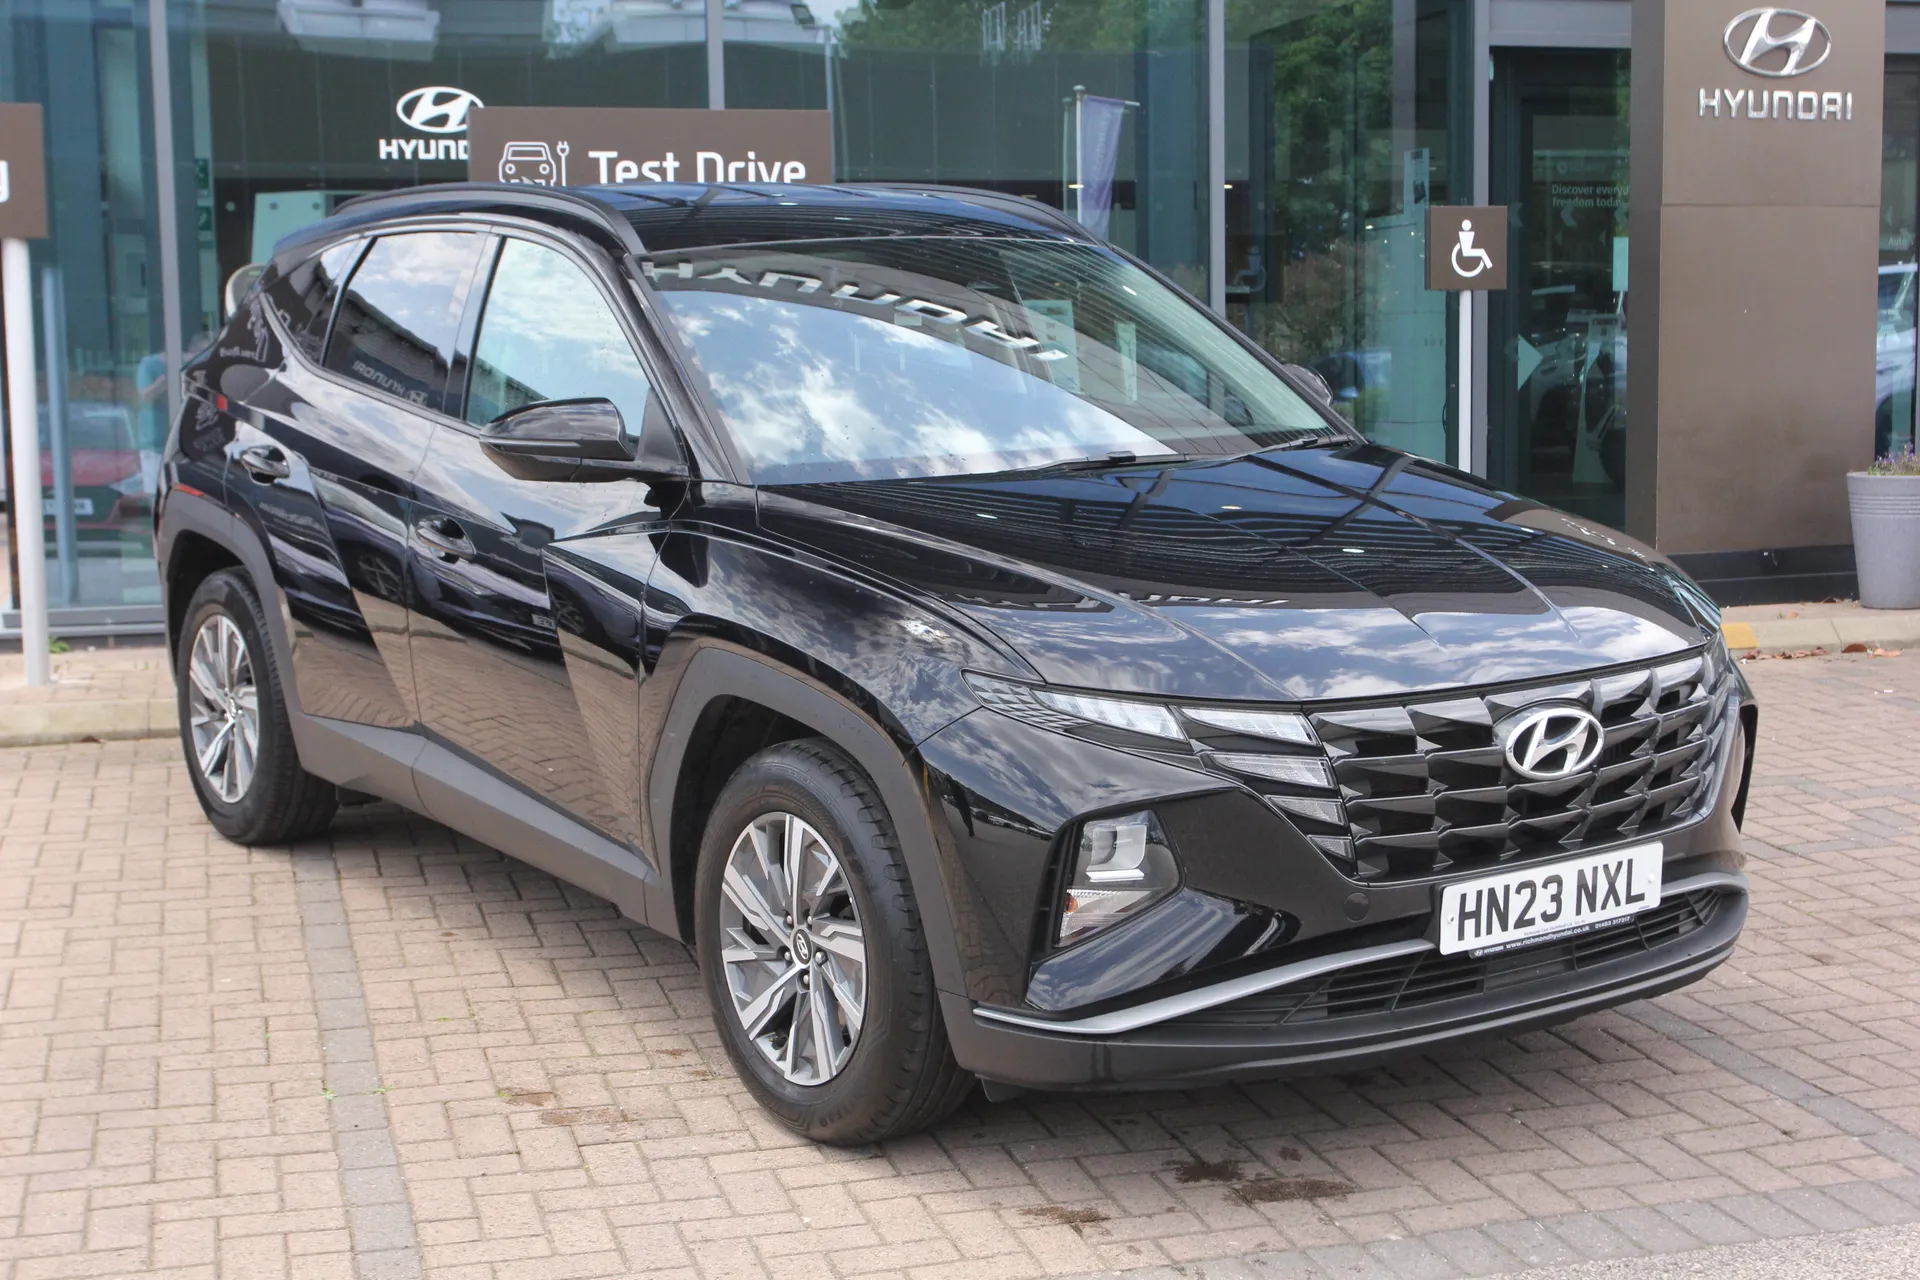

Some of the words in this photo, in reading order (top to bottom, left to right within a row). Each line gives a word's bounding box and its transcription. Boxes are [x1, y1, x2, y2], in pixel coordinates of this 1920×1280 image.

[1699, 88, 1853, 121] HYUNDAI
[588, 150, 680, 184] Test
[696, 150, 806, 184] Drive
[1551, 184, 1593, 195] Discover
[1457, 874, 1564, 942] HN23
[1575, 858, 1646, 916] NXL
[1506, 925, 1590, 949] www.richmondhyundai.co.uk
